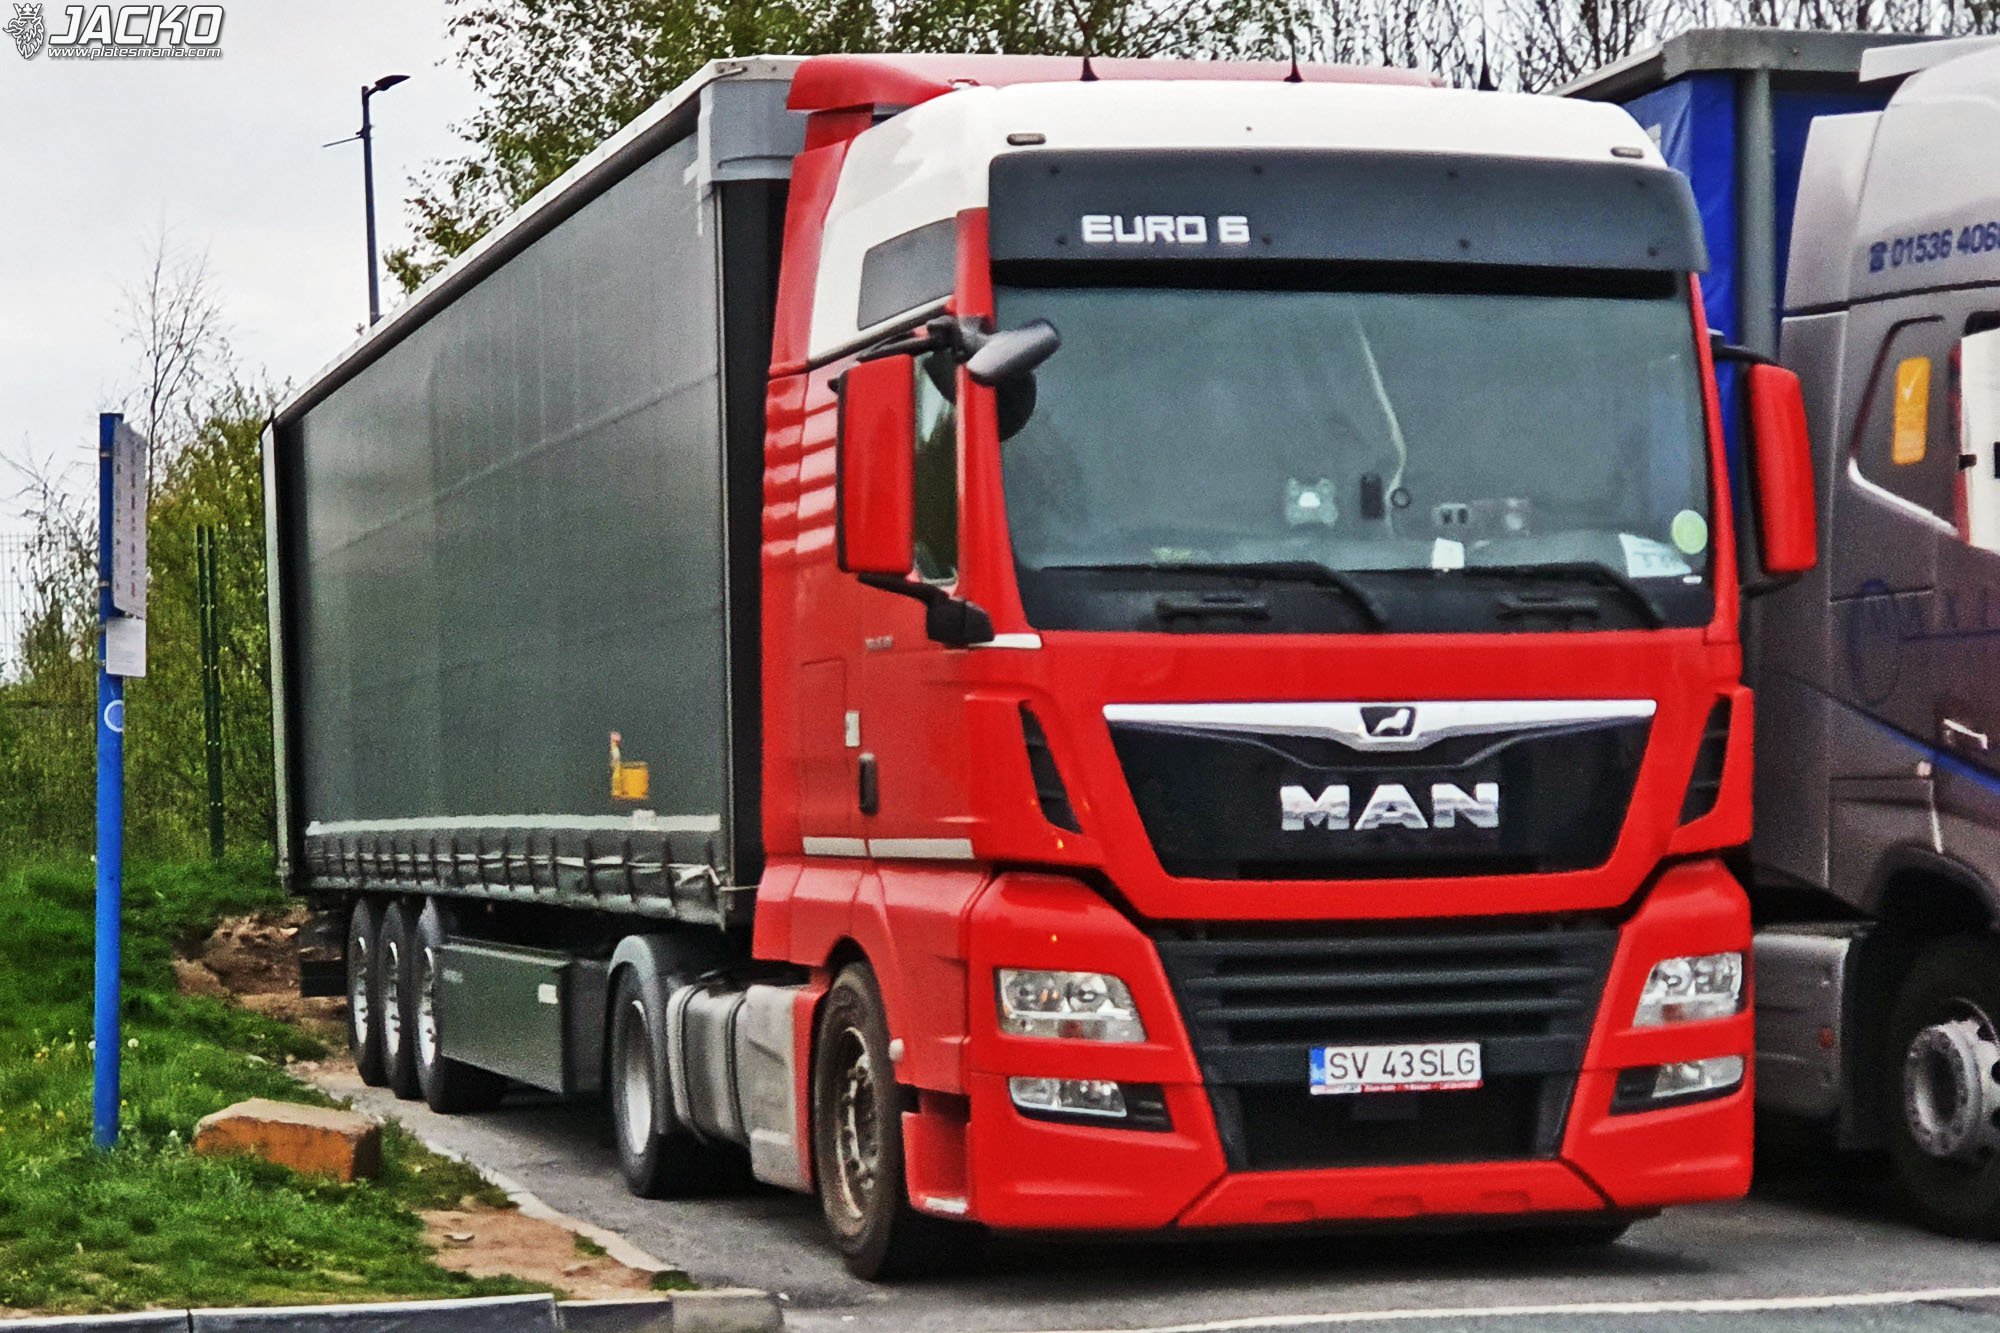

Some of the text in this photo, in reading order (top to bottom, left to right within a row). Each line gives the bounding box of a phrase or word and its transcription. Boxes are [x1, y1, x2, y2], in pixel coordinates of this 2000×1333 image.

[1081, 215, 1251, 243] EURO 6
[1891, 221, 2000, 268] 01536 406
[1280, 782, 1499, 831] MAN
[1329, 1052, 1369, 1080] SV
